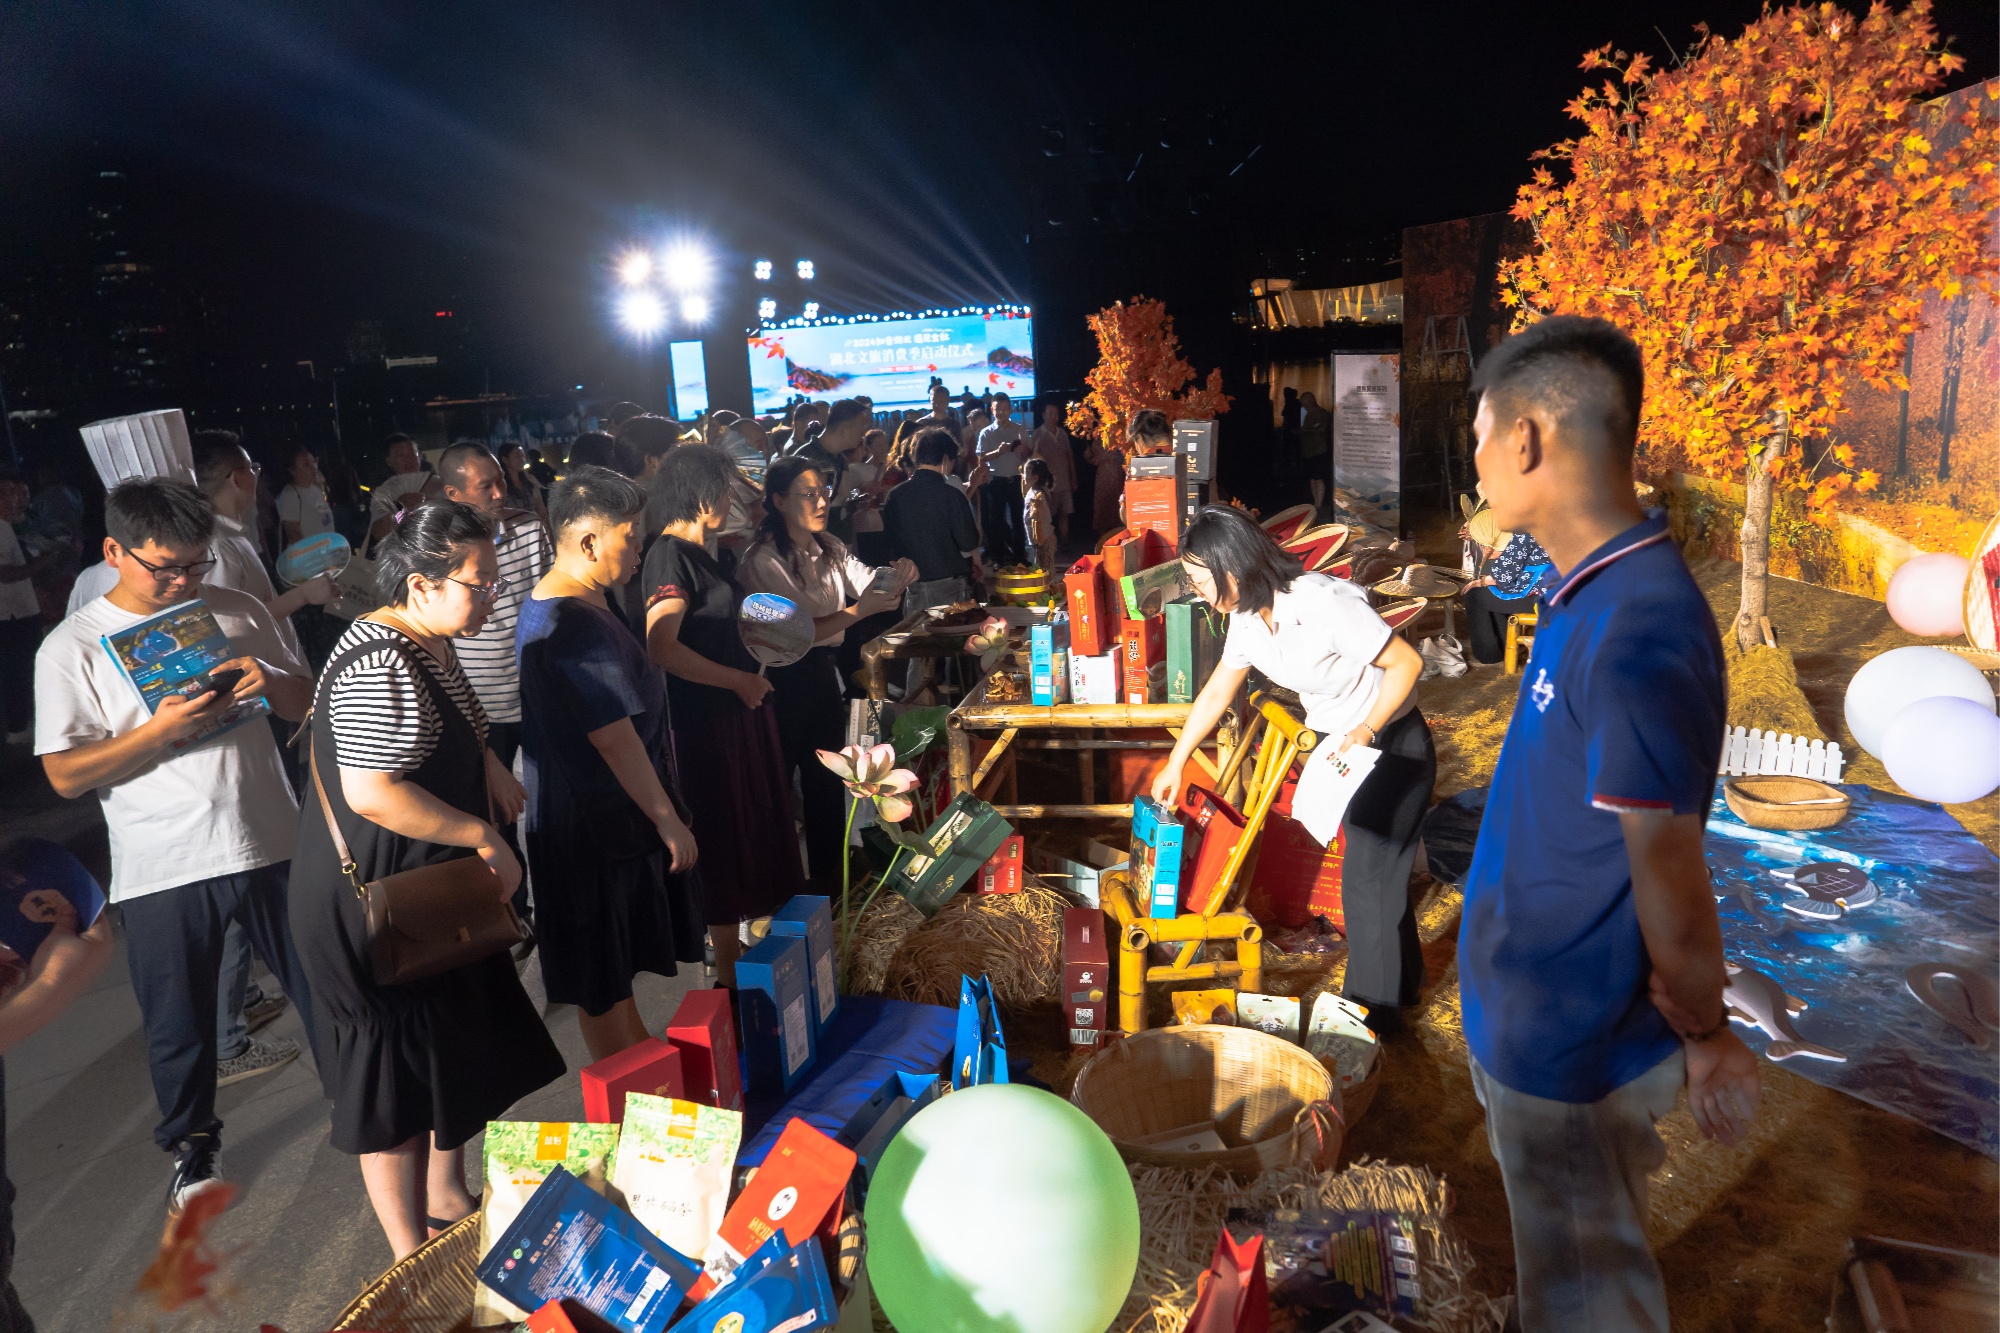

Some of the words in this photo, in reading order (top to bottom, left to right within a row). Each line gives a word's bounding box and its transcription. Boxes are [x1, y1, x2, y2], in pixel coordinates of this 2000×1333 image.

[829, 343, 974, 366] 湖北文旅消费季启动仪式
